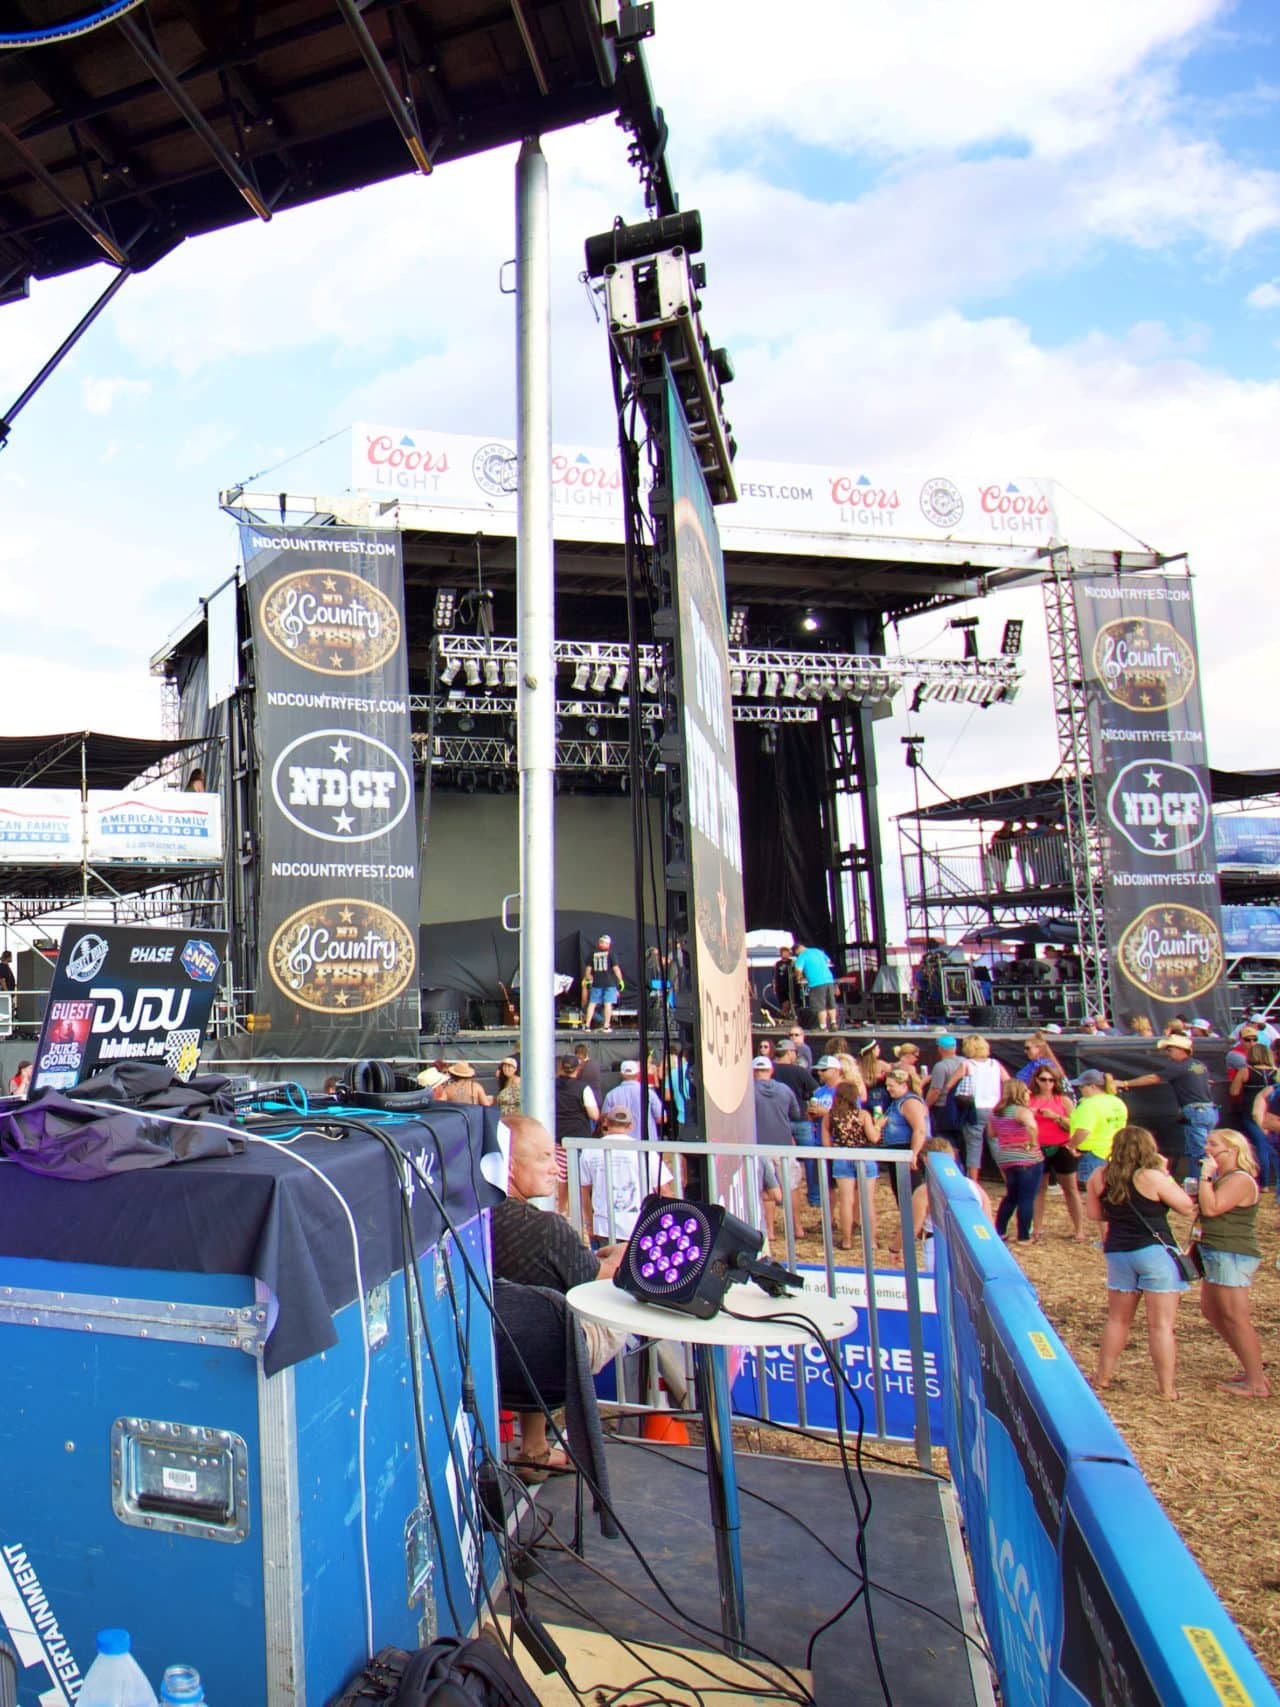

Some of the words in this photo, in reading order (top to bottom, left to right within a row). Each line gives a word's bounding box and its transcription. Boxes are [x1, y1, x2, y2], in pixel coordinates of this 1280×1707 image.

[367, 435, 450, 473] Coors
[376, 468, 442, 491] LIGHT
[551, 456, 621, 490] Coors
[552, 487, 615, 506] LIGHT
[828, 477, 901, 509] Coors
[978, 485, 1049, 516] Coors
[840, 508, 895, 527] LIGHT
[990, 516, 1045, 532] LIGHT
[252, 537, 396, 556] NDCOUNTRYFEST.COM
[298, 594, 380, 638] Country
[307, 625, 367, 651] FEST
[1116, 642, 1182, 675] Country
[267, 692, 406, 714] NDCOUNTRYFEST.COM
[288, 766, 396, 809] NDCF
[101, 813, 163, 824] AMERICAN
[167, 815, 208, 827] FAMILY
[1122, 792, 1200, 826] NDCF
[27, 821, 70, 832] FAMILY
[108, 825, 202, 836] INSURANCE
[272, 862, 415, 879] NDCOUNTRYFEST.COM
[130, 945, 175, 963] PHASE
[310, 929, 396, 970] Country
[191, 950, 217, 977] NFR
[315, 962, 380, 986] FEST
[51, 1002, 94, 1021] GUEST
[89, 988, 192, 1033] DJDU
[49, 1042, 79, 1055] LUKE
[805, 1365, 942, 1398] POUCHES
